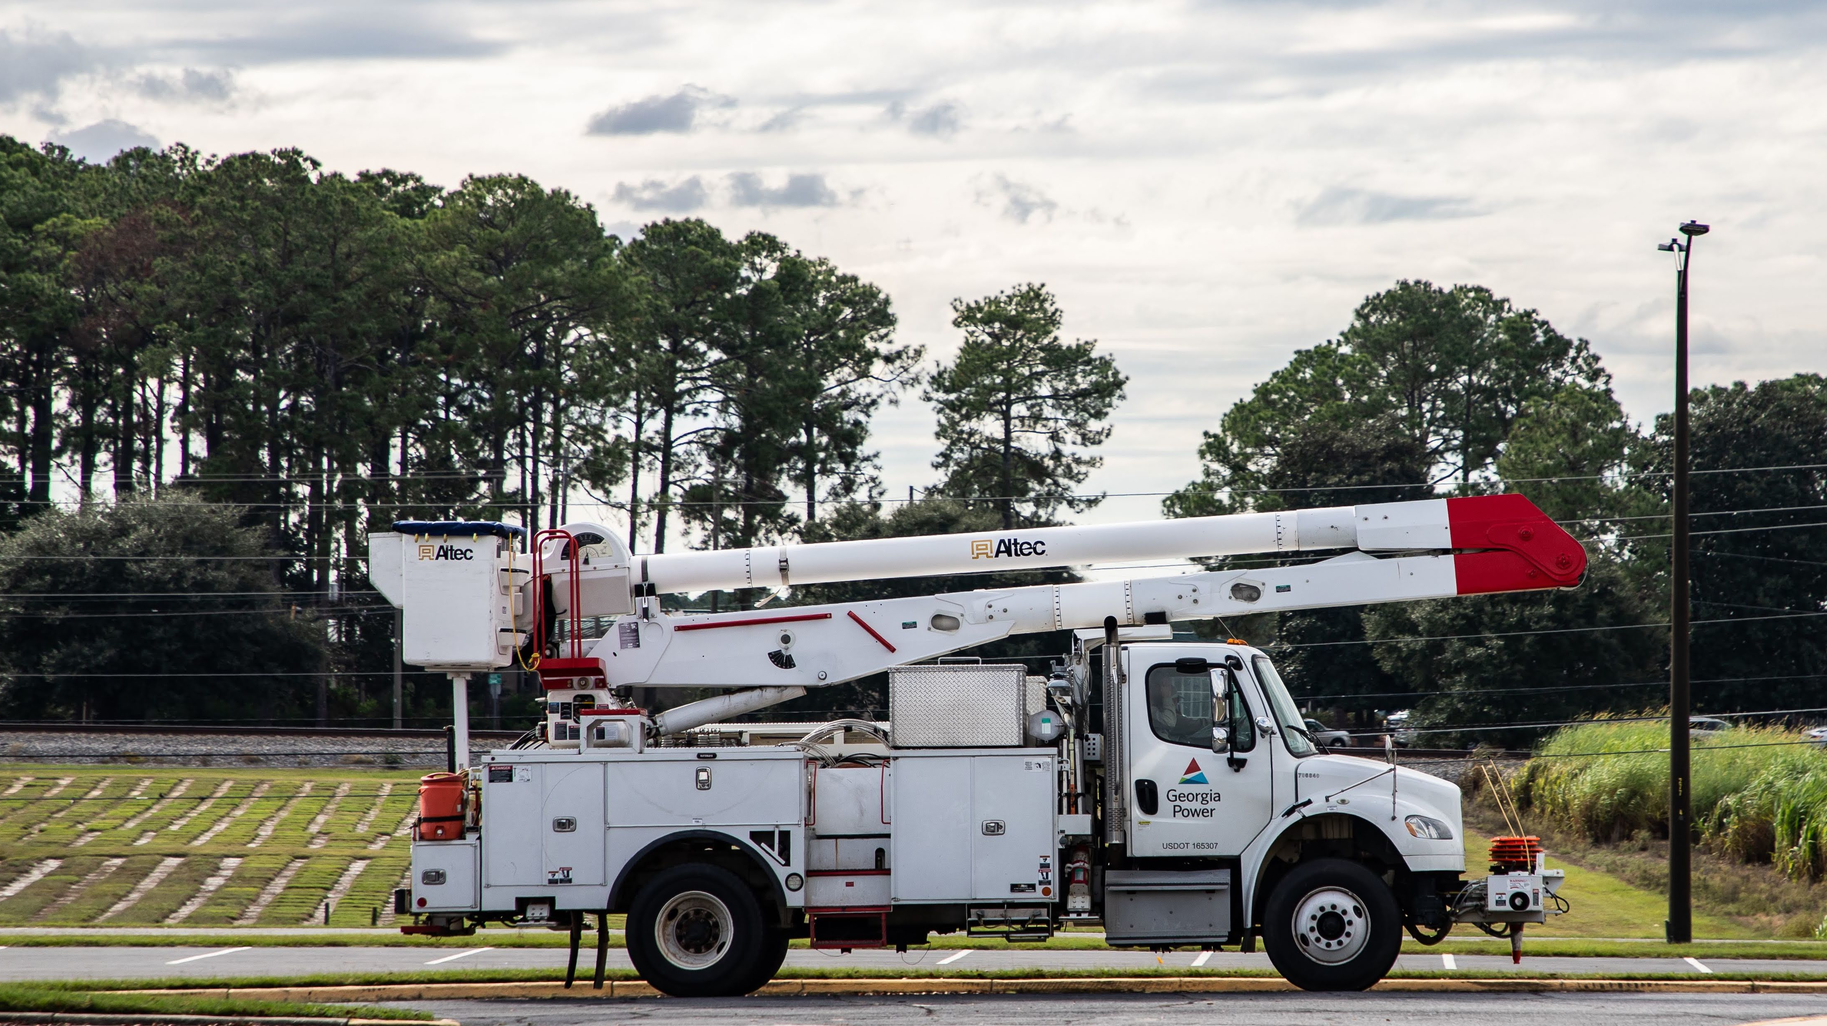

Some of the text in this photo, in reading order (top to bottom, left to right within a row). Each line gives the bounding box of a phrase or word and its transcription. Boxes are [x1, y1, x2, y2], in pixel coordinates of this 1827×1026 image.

[435, 544, 474, 560] Altec
[994, 538, 1046, 558] Altec
[1166, 788, 1221, 805] Georgia
[1173, 804, 1216, 818] Power
[1162, 842, 1219, 850] USDOT 165307
